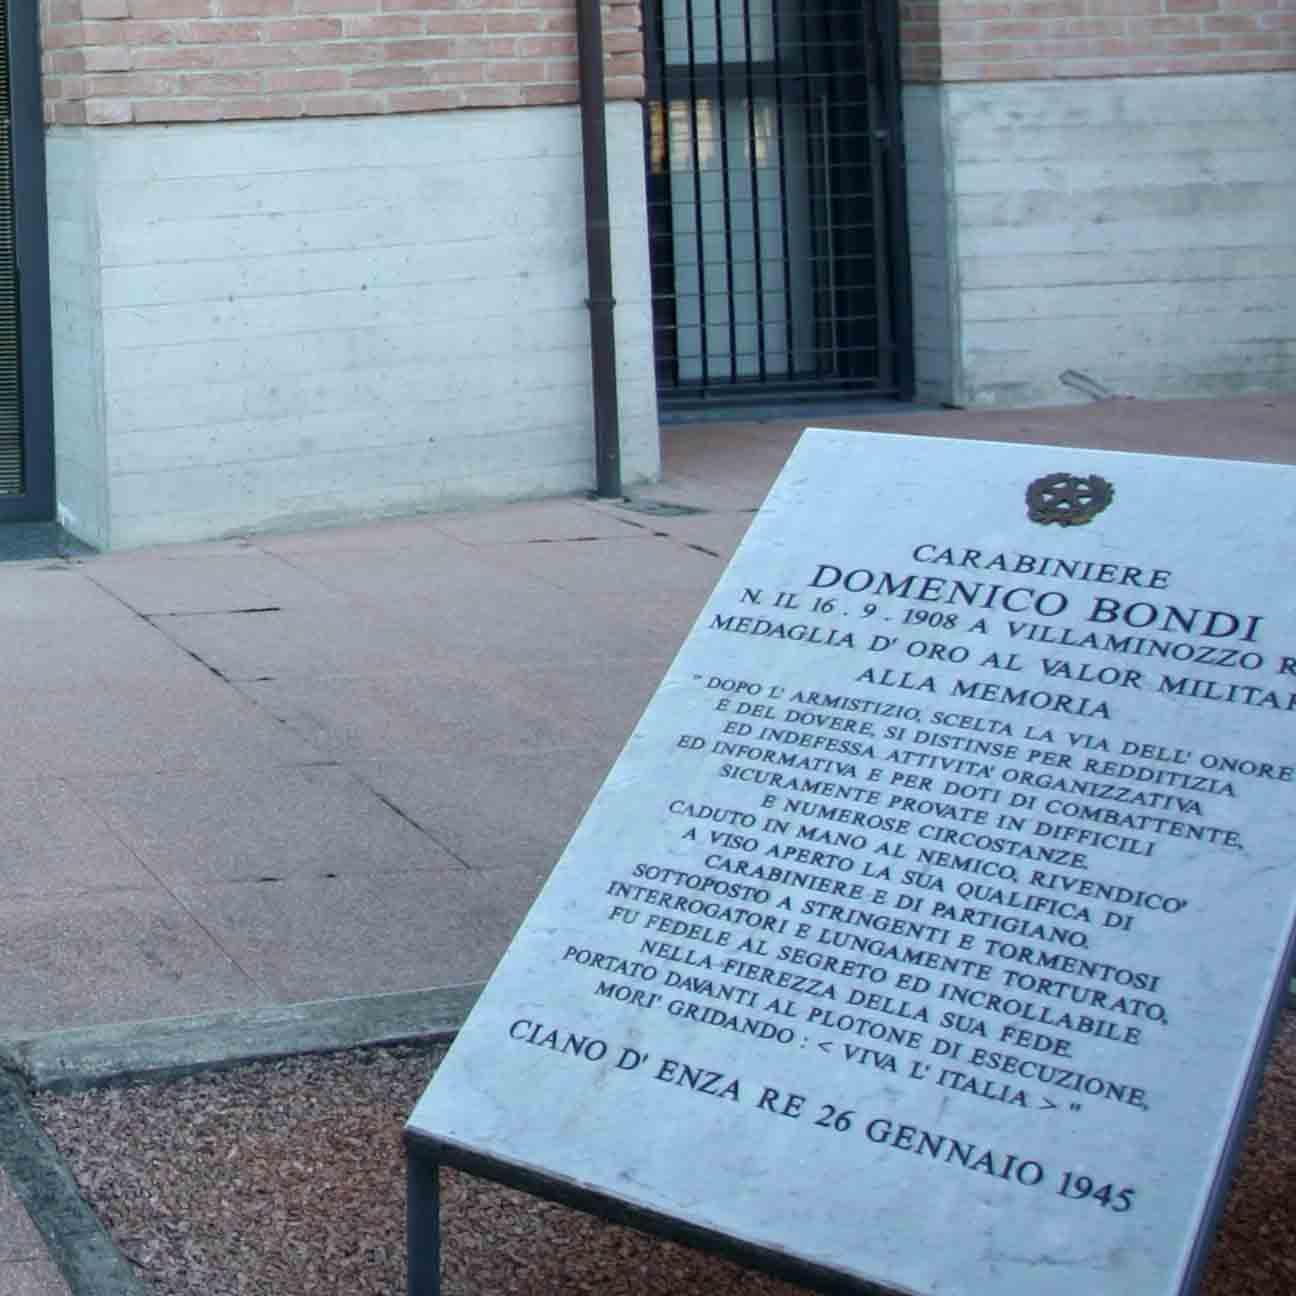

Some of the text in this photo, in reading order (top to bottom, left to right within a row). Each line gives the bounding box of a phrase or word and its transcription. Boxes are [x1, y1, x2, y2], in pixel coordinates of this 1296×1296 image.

[808, 564, 1264, 642] DOMENICO BONDI
[912, 544, 1172, 590] CARABINIERE
[709, 614, 856, 648] MEDAGLIA
[906, 641, 970, 663] ORO
[978, 652, 1023, 671] AL
[1041, 658, 1144, 690] VALOR
[773, 592, 800, 610] IL
[812, 598, 837, 614] 16
[860, 603, 877, 618] 9
[902, 609, 958, 630] 1908
[968, 618, 988, 634] A
[1008, 621, 1264, 670] VILLAMINOZZO
[704, 676, 762, 695] DOPO
[930, 712, 1012, 736] SCELTA
[1024, 726, 1054, 742] LA
[1069, 732, 1110, 752] VIA
[1200, 754, 1294, 782] ONORE
[856, 668, 1111, 720] ALLA MEMORIA
[676, 735, 706, 750] ED
[712, 741, 856, 778] INFORMATIVA
[866, 768, 883, 782] E
[890, 772, 933, 792] PER
[942, 781, 1002, 803] DOTI
[1008, 793, 1037, 810] DI
[715, 698, 730, 711] E
[736, 702, 776, 720] DEL
[884, 726, 906, 741] SI
[913, 730, 1018, 759] DISTINSE
[1026, 750, 1072, 768] PER
[1082, 758, 1236, 798] REDDITIZIA
[722, 721, 752, 736] ED
[758, 728, 875, 759] INDEFESSA
[1002, 768, 1203, 816] ORGANIZZATIVA
[669, 800, 756, 828] CADUTO
[762, 818, 791, 835] IN
[796, 825, 867, 850] MANO
[874, 842, 906, 858] AL
[719, 764, 1156, 856] SICURAMENTE PROVATE IN DIFFICILI
[760, 794, 776, 808] E
[784, 798, 912, 834] NUMEROSE
[682, 827, 1134, 931] A VISO APERTO LA SUA QUALIFICA DI
[704, 854, 864, 899] CARABINIERE
[872, 889, 888, 904] E
[894, 894, 924, 912] DI
[606, 880, 789, 934] INTERROGATORI
[794, 923, 812, 939] E
[816, 928, 992, 980] LUNGAMENTE
[608, 906, 1142, 1045] FU FEDELE AL SEGRETO ED INCROLLABILE
[632, 864, 1160, 992] SOTTOPOSTO A STRINGENTI E TORMENTOSI
[562, 946, 658, 981] PORTATO
[664, 970, 759, 1008] DAVANTI
[763, 998, 796, 1018] AL
[806, 1008, 923, 1048] PLOTONE
[930, 1038, 963, 1059] DI
[640, 939, 712, 970] NELLA
[720, 958, 836, 1000] FIEREZZA
[846, 989, 928, 1023] DELLA
[940, 1012, 987, 1038] SUA
[667, 1000, 794, 1044] GRIDANDO
[844, 1044, 896, 1072] VIVA
[936, 1069, 1028, 1108] ITALIA
[509, 1019, 608, 1061] CIANO
[654, 1058, 739, 1102] ENZA
[756, 1087, 806, 1118] RE
[814, 1104, 856, 1132] 26
[866, 1118, 1044, 1185] GENNAIO
[1056, 1172, 1136, 1212] 1945
